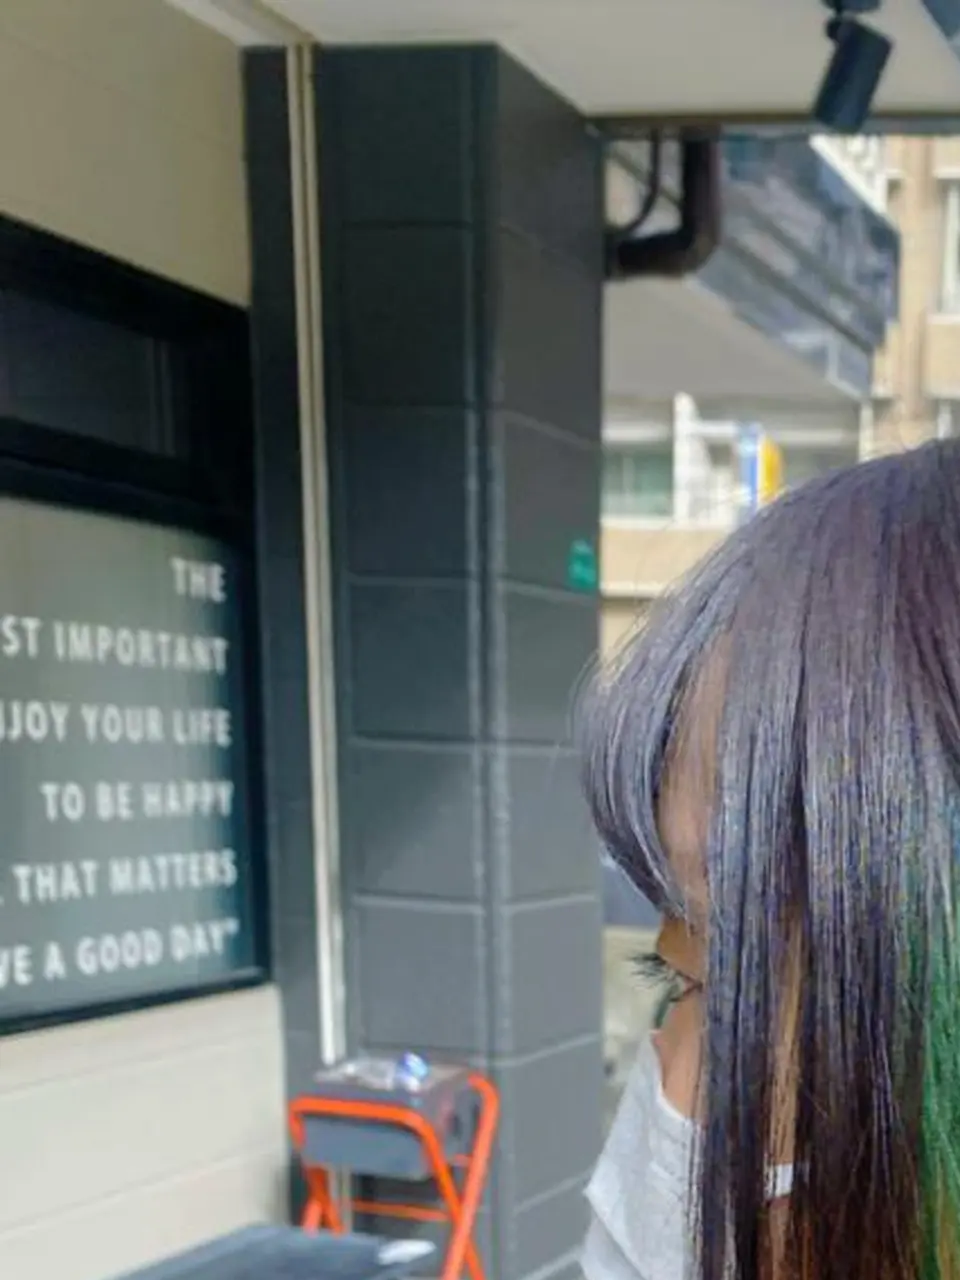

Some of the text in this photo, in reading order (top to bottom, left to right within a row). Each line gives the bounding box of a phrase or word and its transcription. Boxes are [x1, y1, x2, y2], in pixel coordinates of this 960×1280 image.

[171, 557, 227, 602] THE
[54, 620, 229, 675] IMPORTANT
[81, 703, 163, 744] YOUR
[172, 708, 232, 747] LIFE
[40, 780, 234, 822] TO BE HAPPY
[12, 849, 237, 905] THAT MATTERS
[43, 941, 66, 981] A
[78, 927, 163, 976] GOOD
